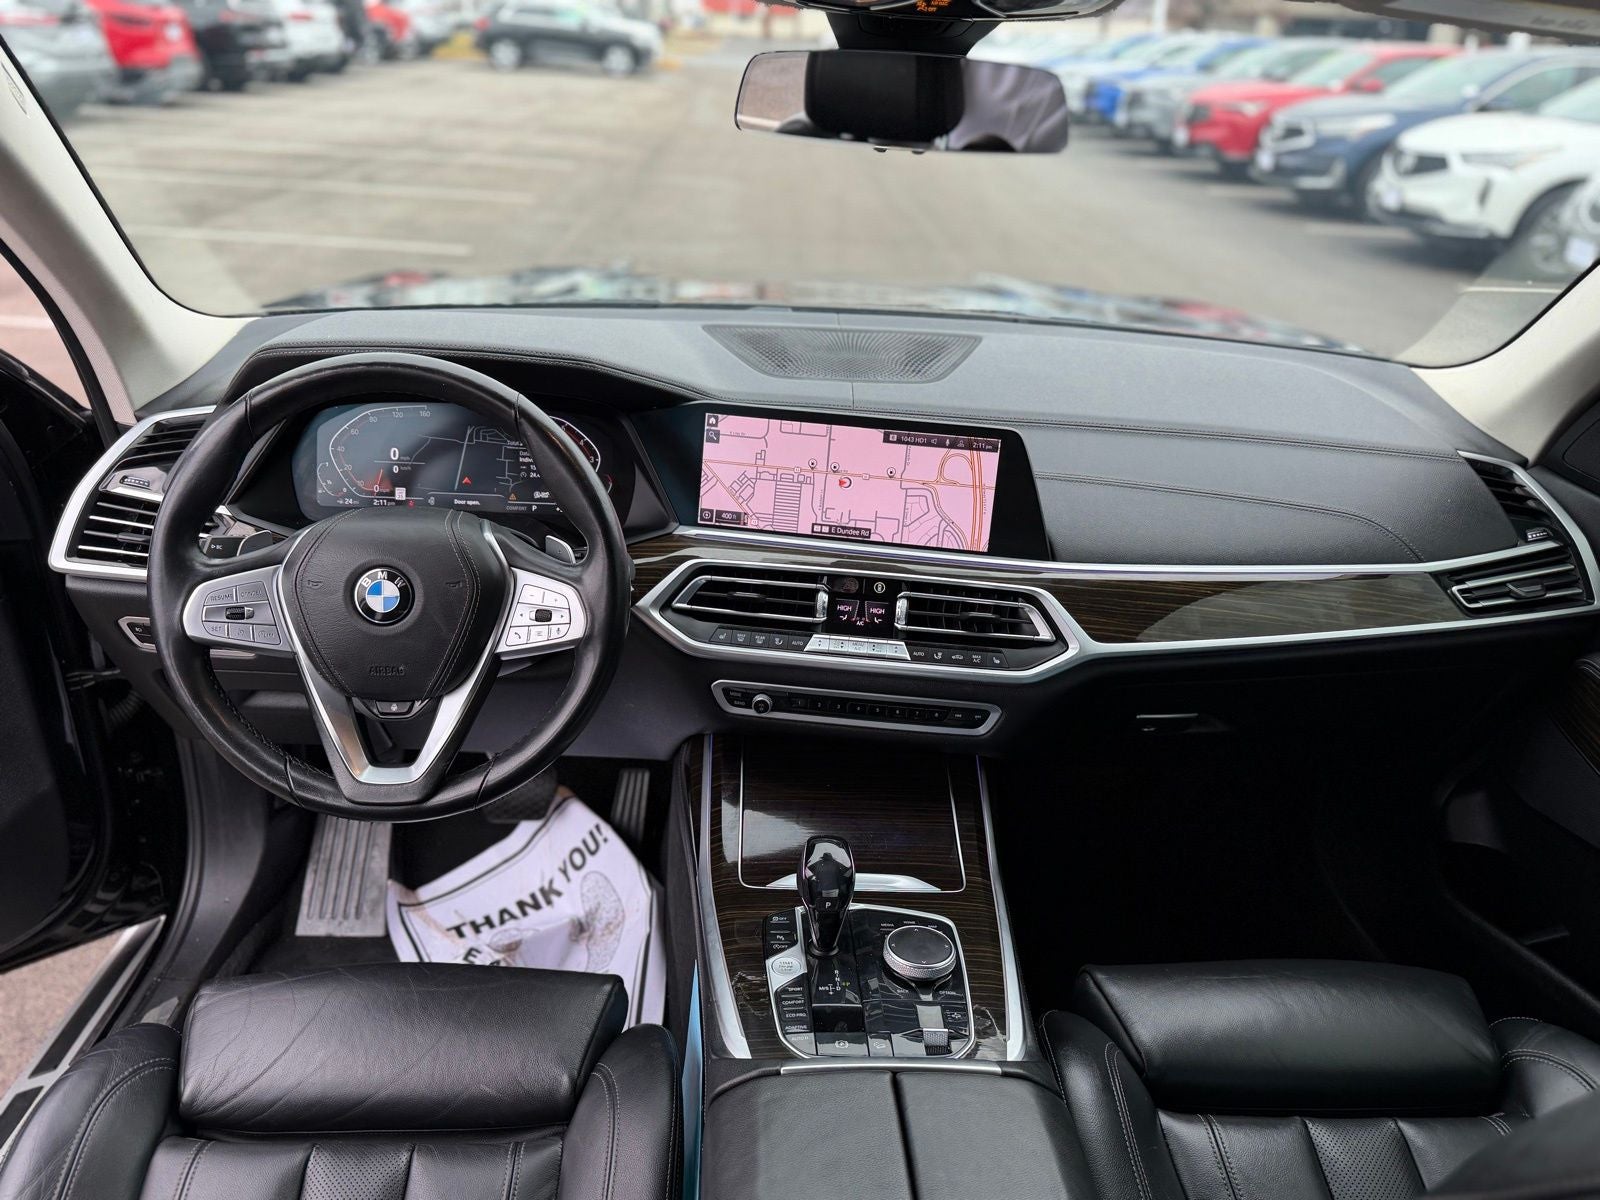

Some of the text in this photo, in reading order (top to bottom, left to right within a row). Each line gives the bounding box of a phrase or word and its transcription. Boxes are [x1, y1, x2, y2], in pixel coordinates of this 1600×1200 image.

[390, 447, 399, 460] 0
[392, 465, 399, 473] 0
[373, 484, 380, 492] 0
[721, 512, 732, 520] 400
[836, 527, 860, 536] Dundee
[860, 529, 870, 537] Rd
[361, 571, 406, 588] BMW
[837, 604, 852, 612] HIGH
[446, 823, 609, 938] THANK YOU!
[825, 901, 832, 909] P
